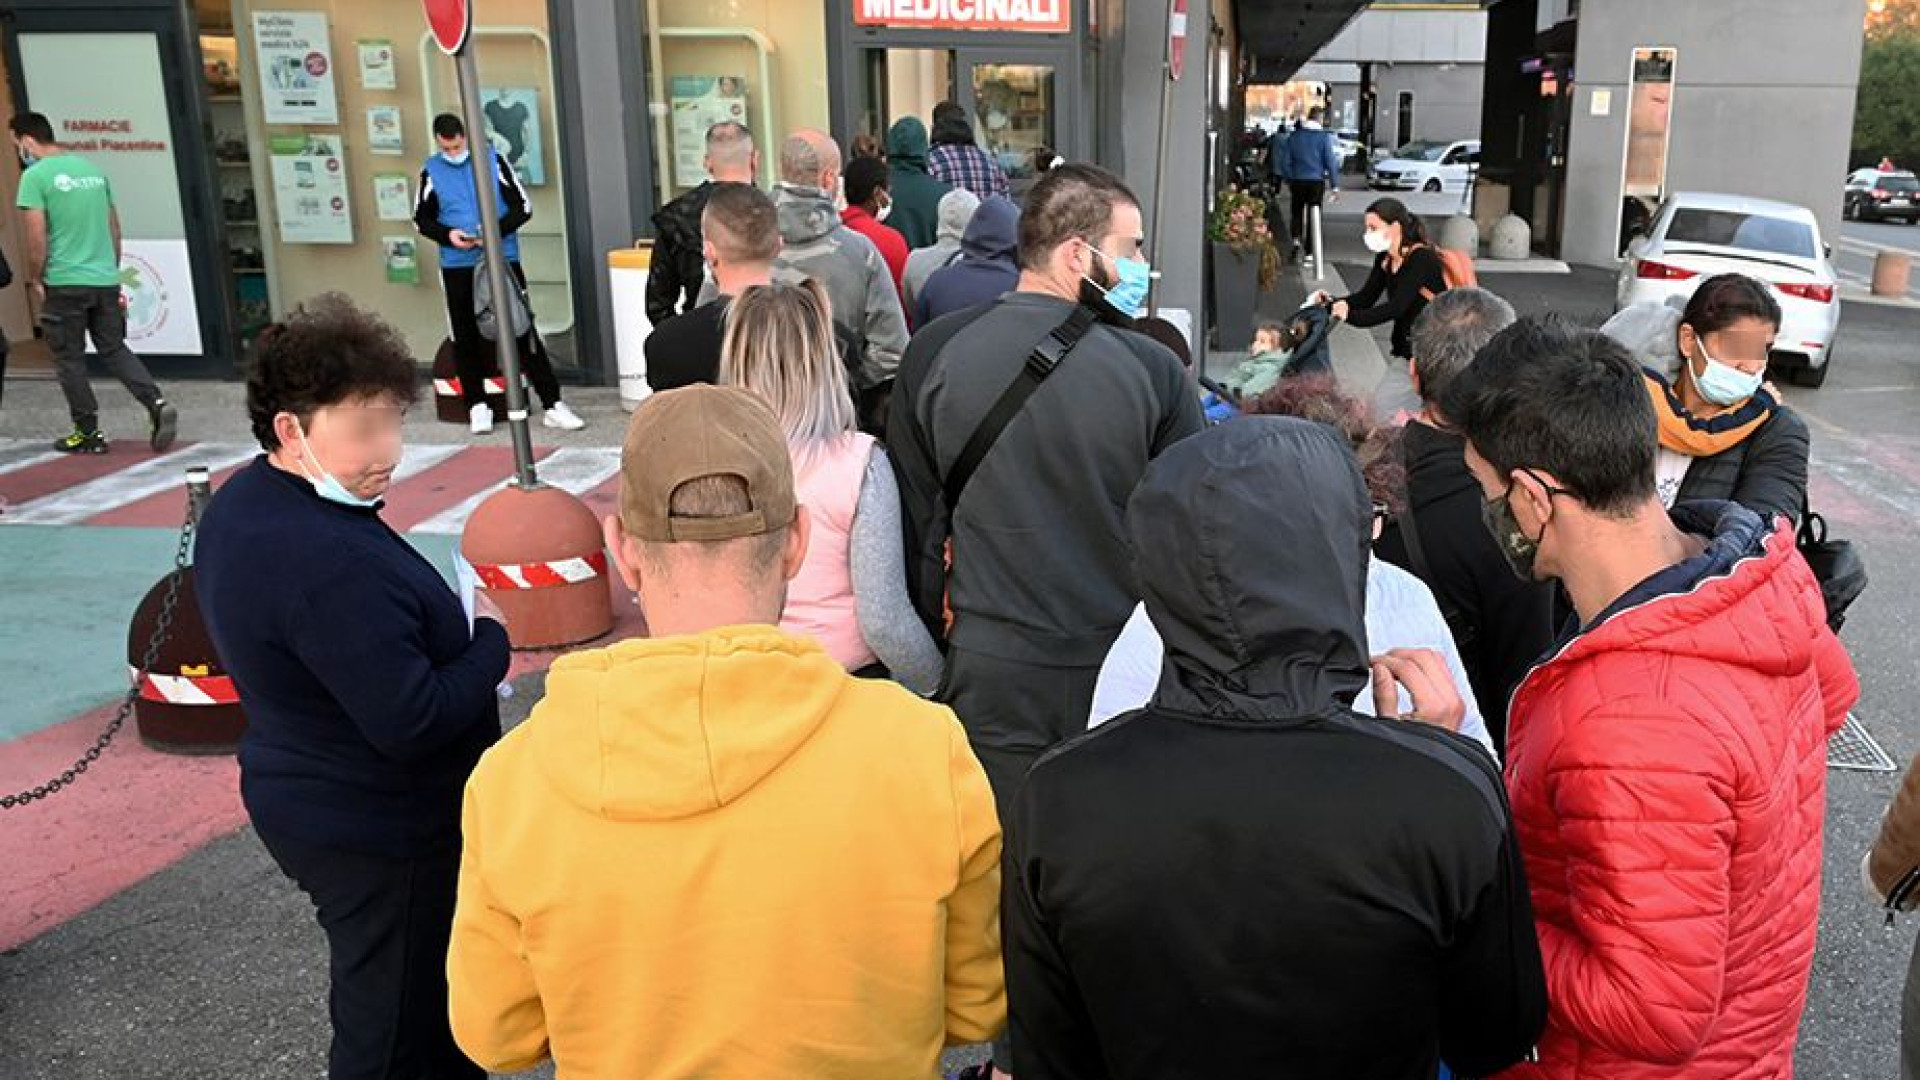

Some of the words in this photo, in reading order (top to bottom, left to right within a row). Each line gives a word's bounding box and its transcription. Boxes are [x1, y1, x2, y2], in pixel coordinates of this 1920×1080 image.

[863, 0, 1060, 22] MEDICINALI
[63, 119, 132, 132] FARMACIE
[101, 139, 166, 152] Piacentine
